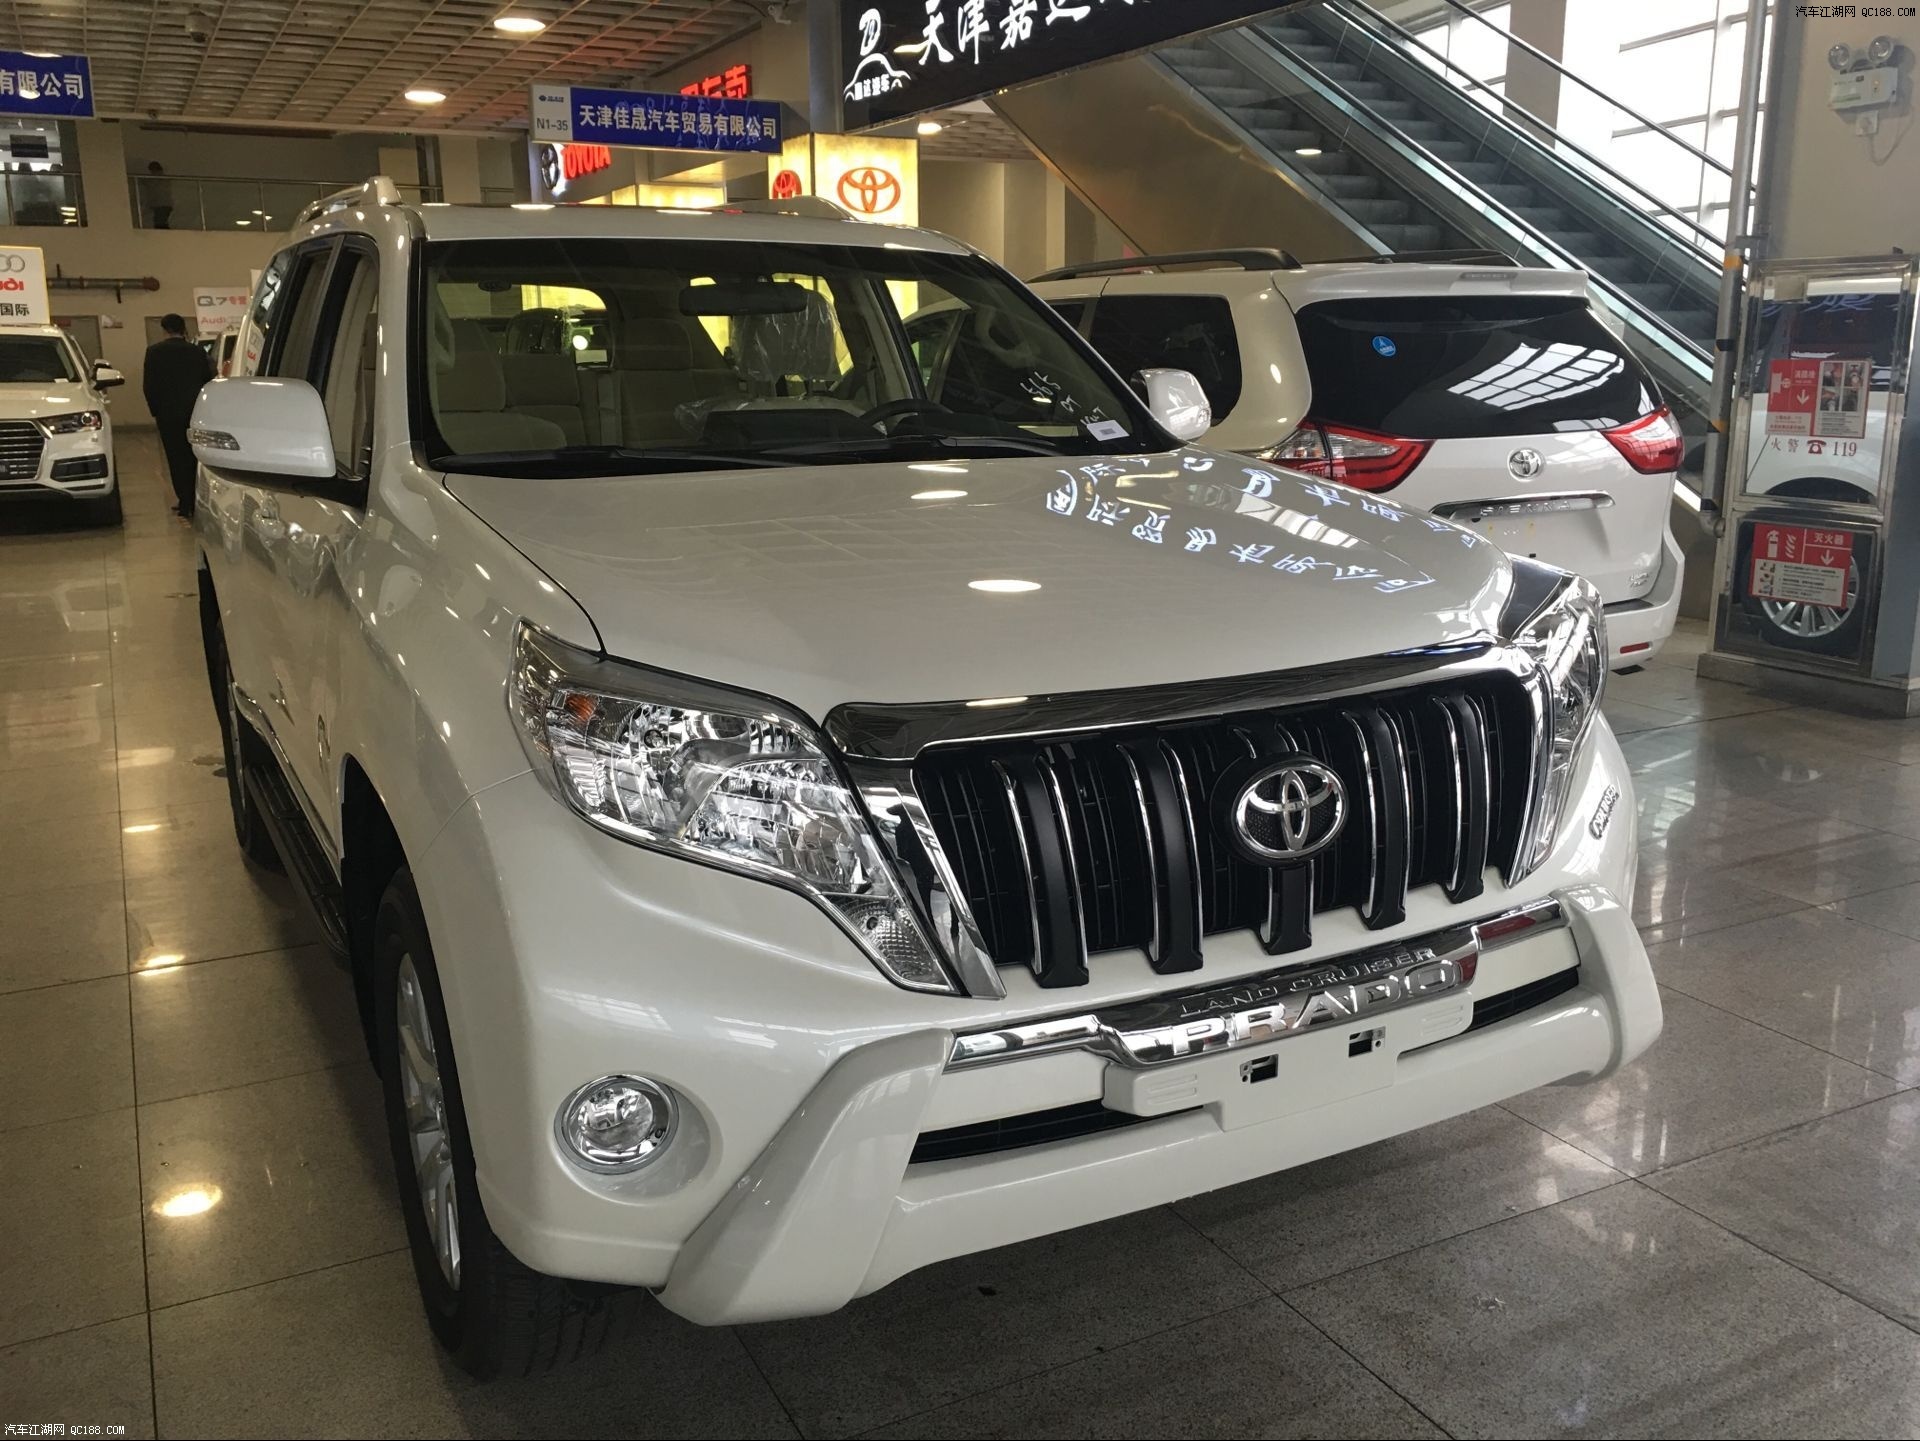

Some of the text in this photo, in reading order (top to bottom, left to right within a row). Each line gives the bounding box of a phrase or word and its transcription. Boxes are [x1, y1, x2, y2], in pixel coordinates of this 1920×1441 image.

[0, 69, 84, 99] 有限公司
[536, 118, 569, 131] N1-35
[197, 295, 227, 307] Q7
[1833, 441, 1857, 456] 119
[1180, 948, 1437, 1018] LAND CRUISER
[1172, 959, 1462, 1056] PRADO
